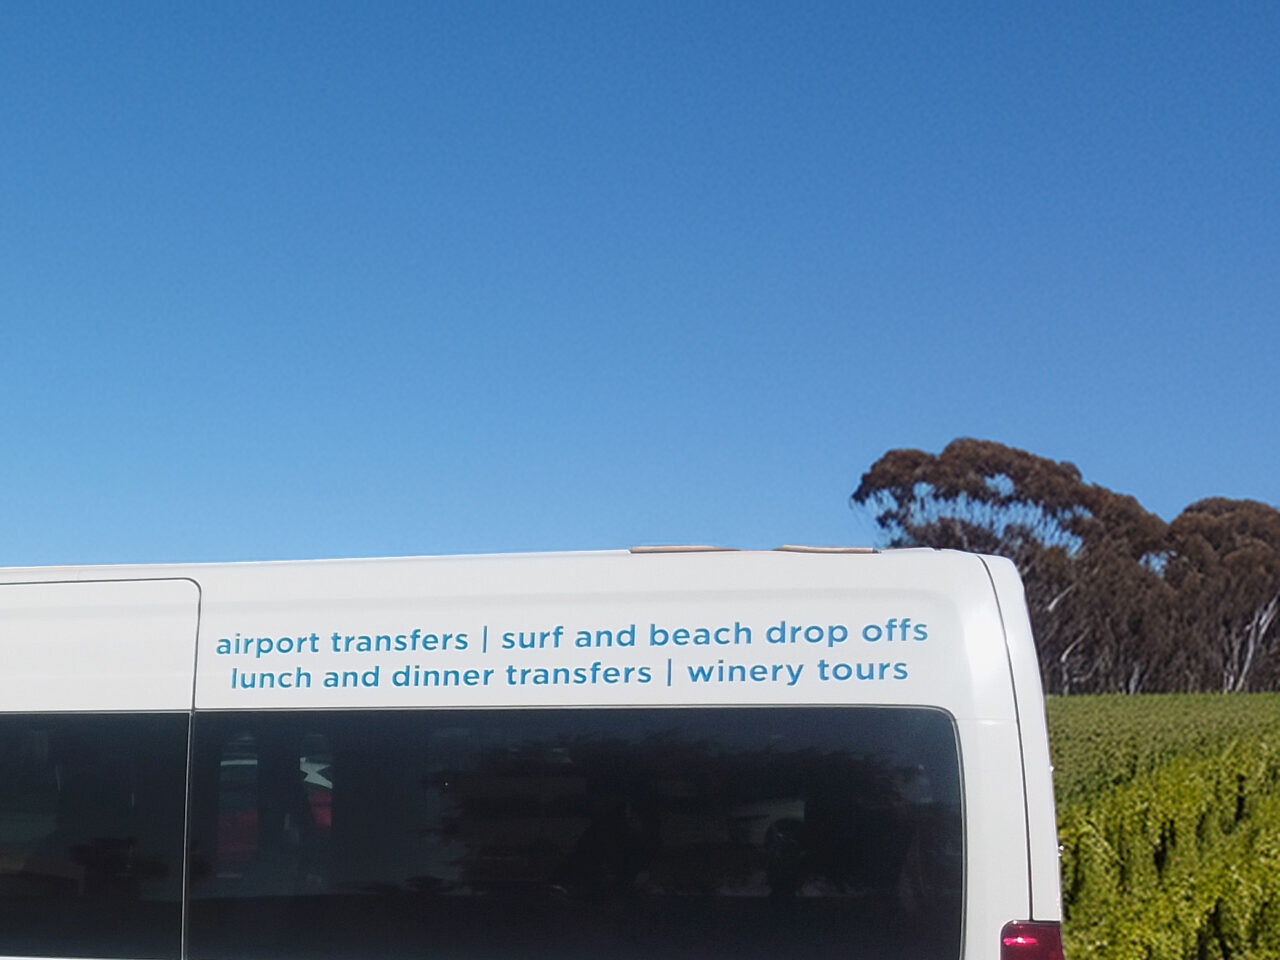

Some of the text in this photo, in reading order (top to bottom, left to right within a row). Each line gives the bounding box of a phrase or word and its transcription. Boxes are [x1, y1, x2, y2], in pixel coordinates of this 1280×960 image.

[216, 633, 319, 659] airport
[331, 628, 469, 653] transfers
[502, 625, 563, 650] surf
[575, 624, 636, 648] and
[649, 622, 752, 647] beach
[766, 621, 849, 648] drop
[862, 618, 928, 643] offs
[231, 667, 311, 689] lunch
[323, 665, 380, 688] and
[391, 665, 494, 687] dinner
[506, 661, 652, 686] transfers
[688, 664, 803, 687] winery
[818, 660, 908, 681] tours
